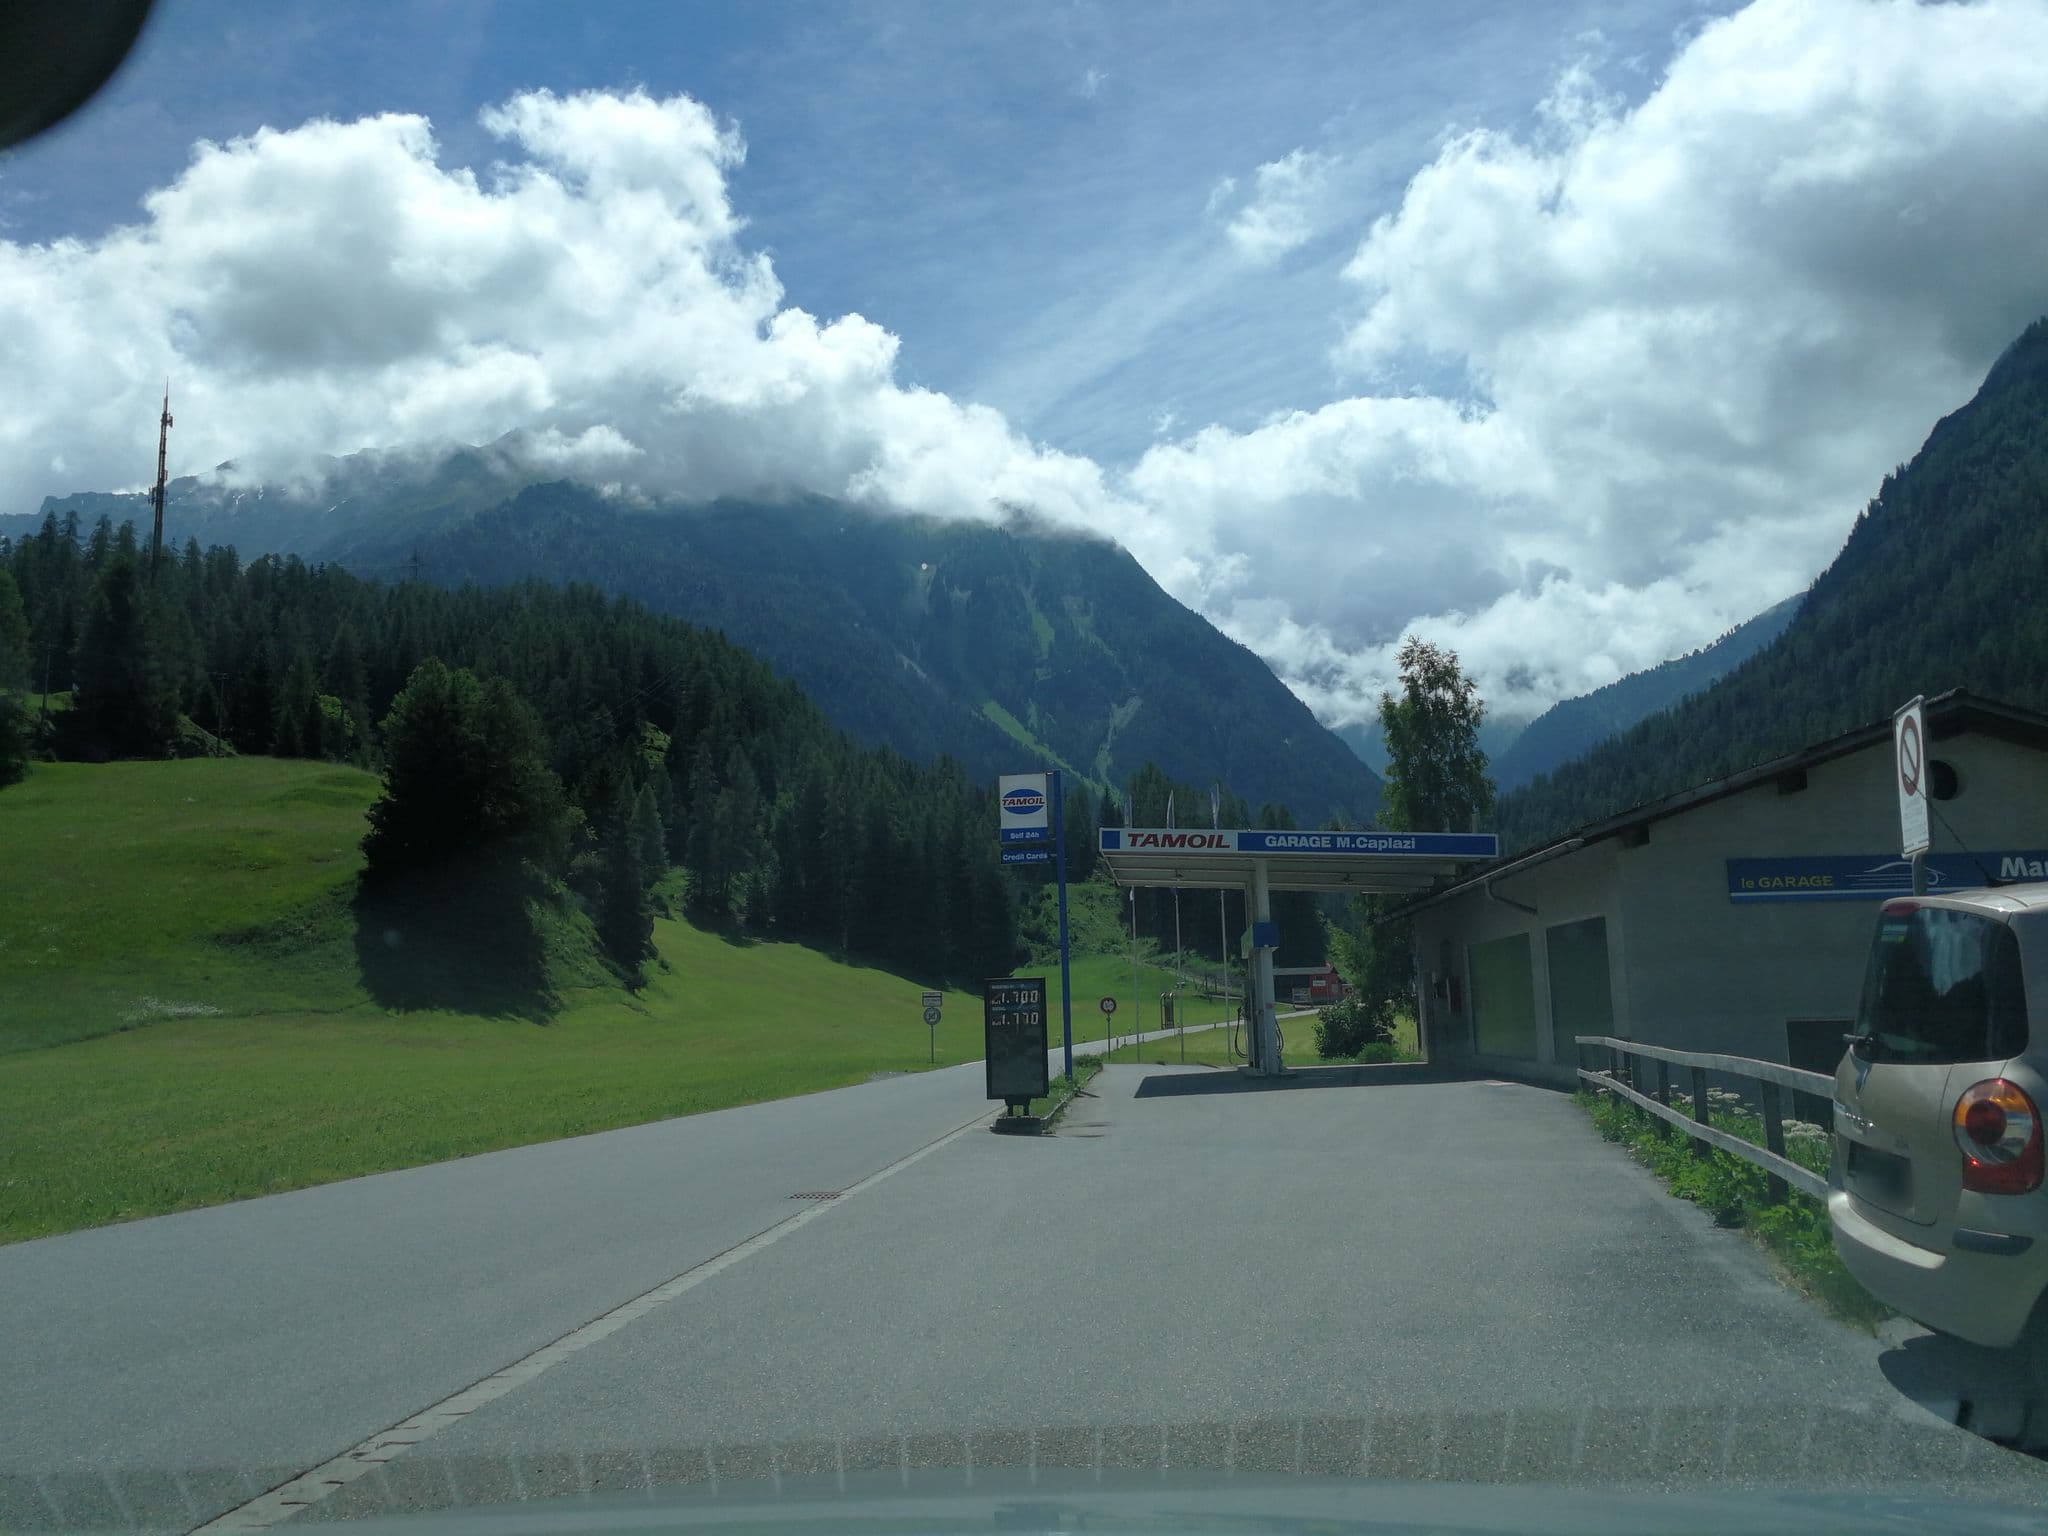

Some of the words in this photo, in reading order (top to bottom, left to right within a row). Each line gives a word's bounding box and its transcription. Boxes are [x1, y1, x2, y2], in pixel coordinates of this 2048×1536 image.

[1002, 796, 1045, 806] TAMOIL
[1128, 833, 1230, 848] TAMOIL
[1265, 835, 1331, 848] GARAGE
[1337, 837, 1415, 850] M.Caplazi
[1741, 877, 1754, 888] le
[1758, 875, 1833, 888] GARAGE
